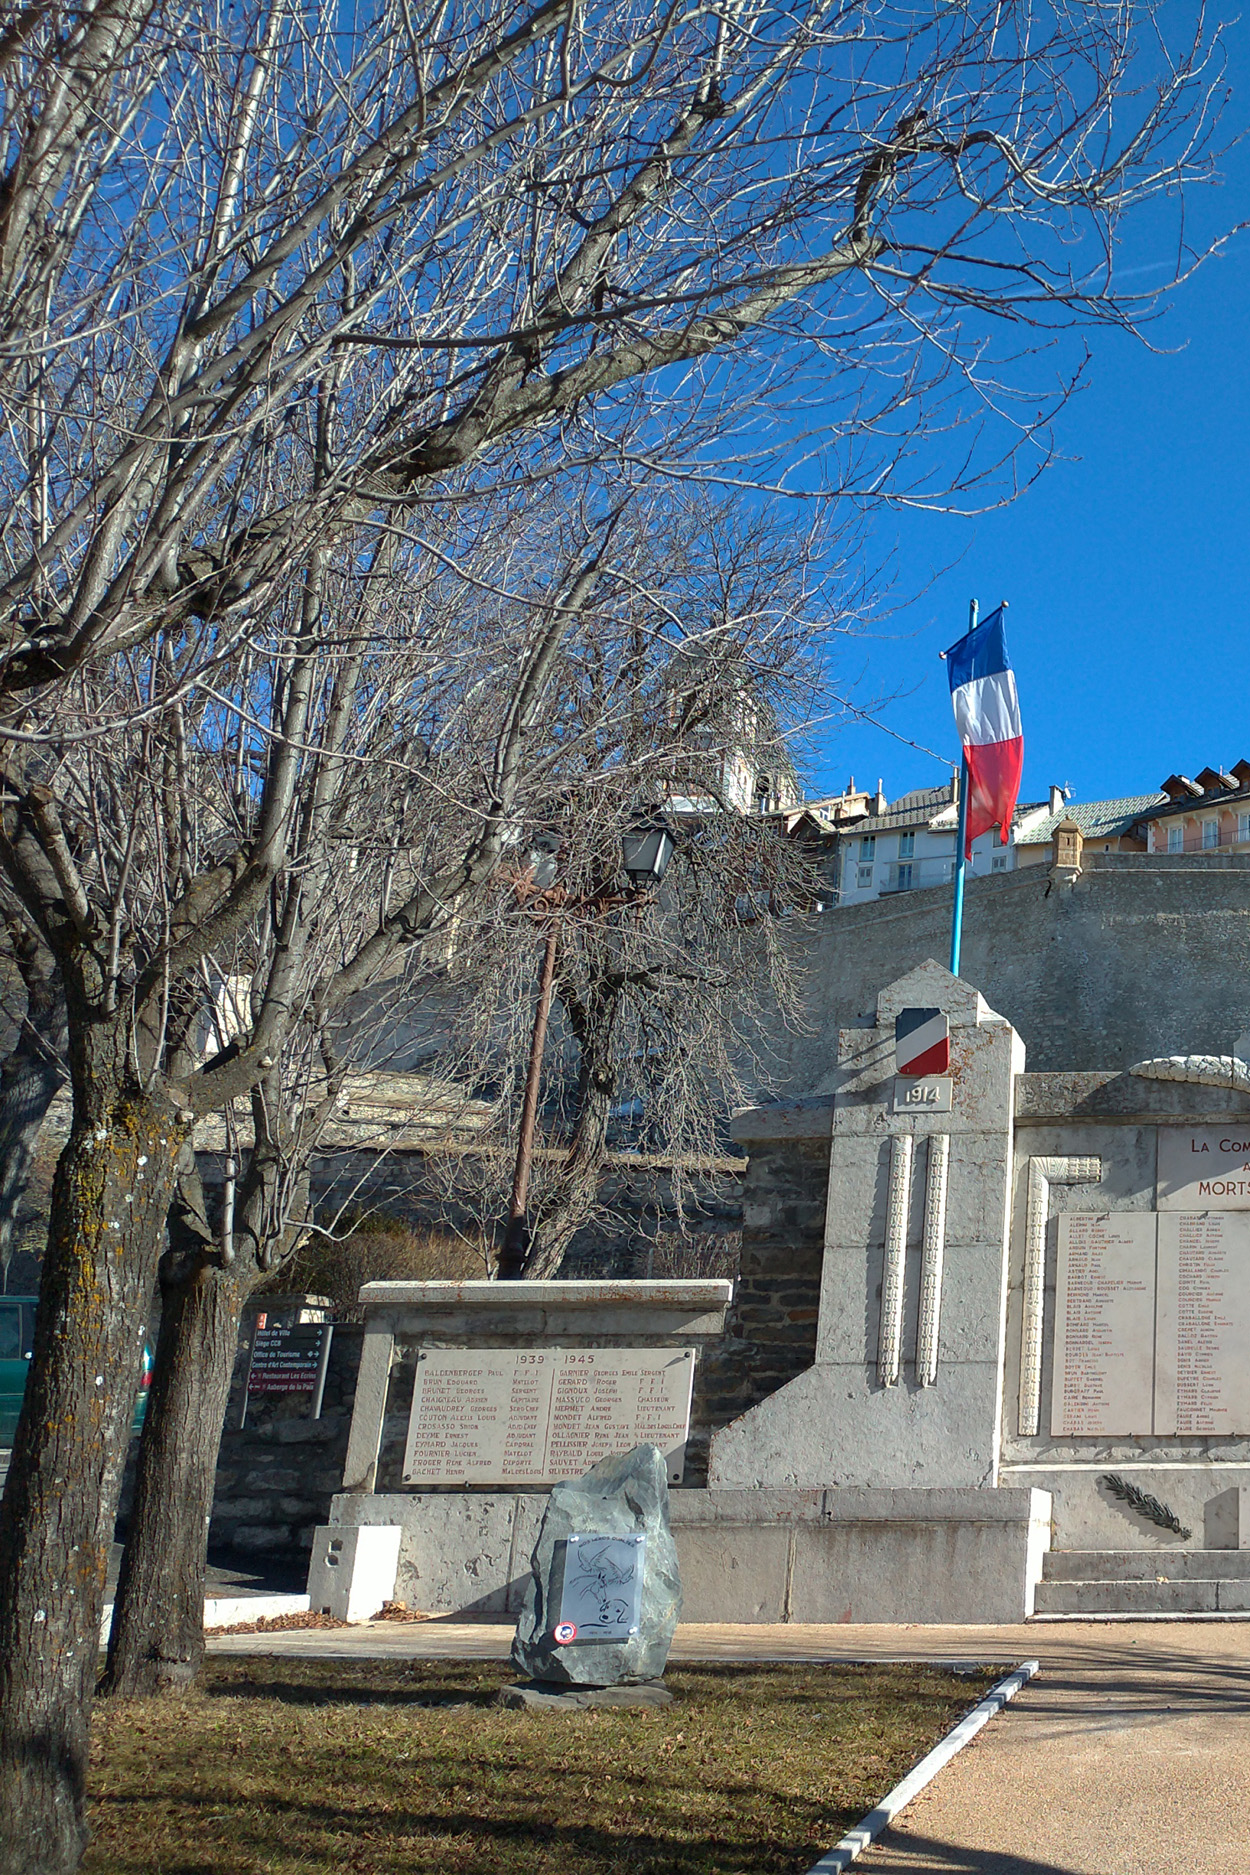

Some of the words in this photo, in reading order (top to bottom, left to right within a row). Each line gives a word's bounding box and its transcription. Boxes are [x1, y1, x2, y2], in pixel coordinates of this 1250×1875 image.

[906, 1086, 940, 1102] 1914
[515, 1355, 545, 1364] 1939
[564, 1355, 594, 1364] 1945
